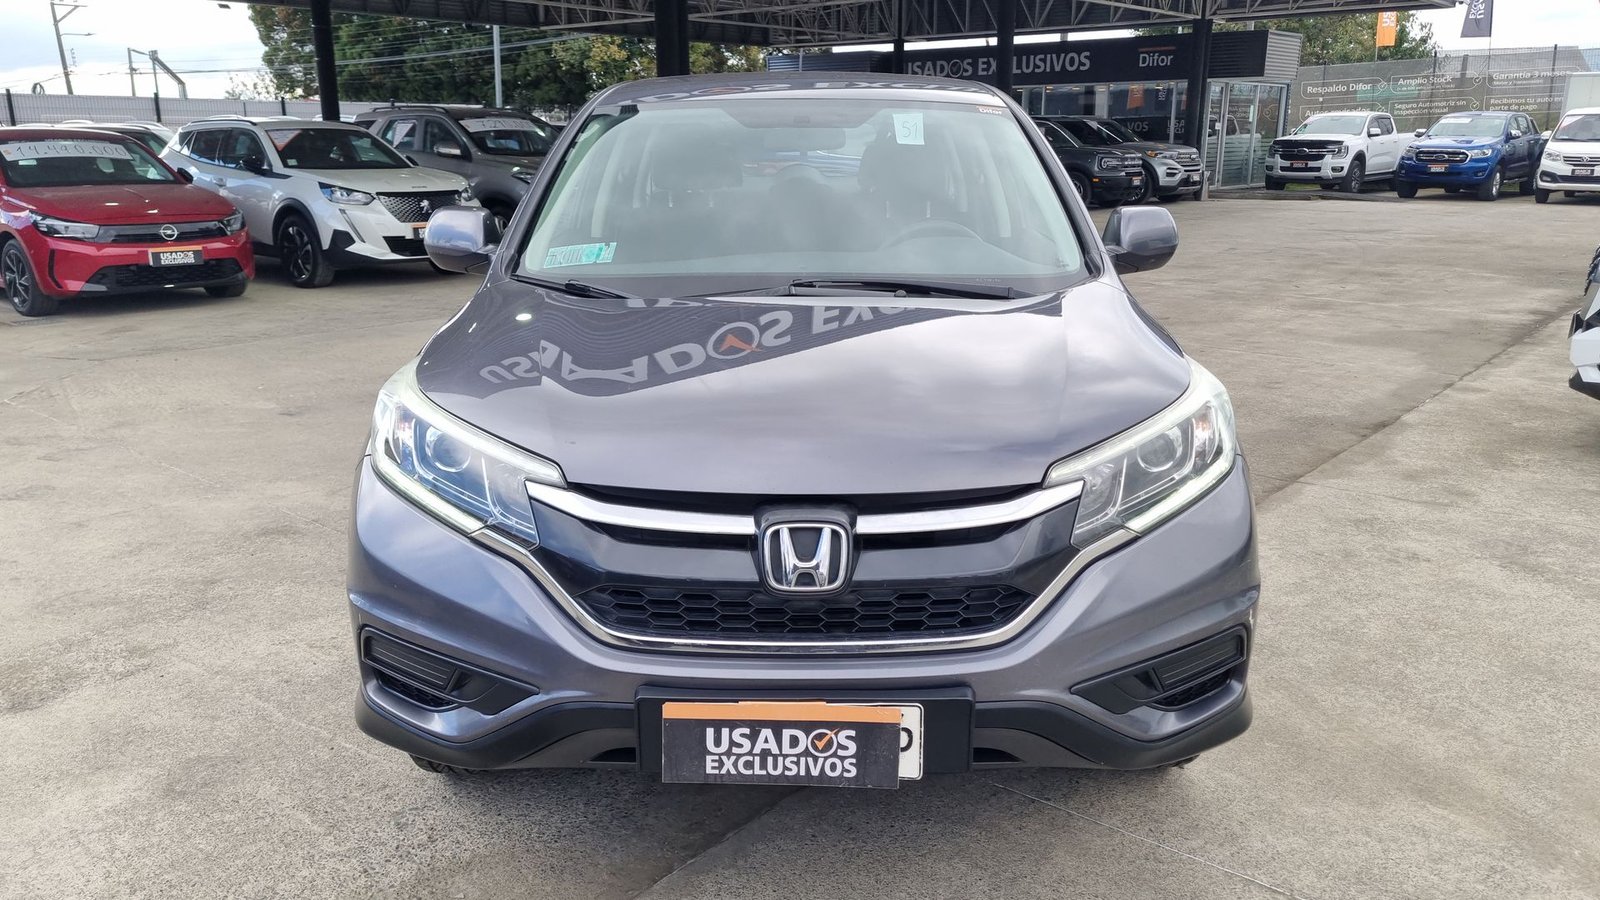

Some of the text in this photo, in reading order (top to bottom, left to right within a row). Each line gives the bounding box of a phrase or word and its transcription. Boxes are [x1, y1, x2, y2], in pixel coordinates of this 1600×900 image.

[1139, 53, 1174, 67] Difor
[1398, 75, 1453, 86] Amplio Stock
[1532, 70, 1539, 79] 3
[1307, 82, 1373, 95] Respaldo Difor
[1394, 101, 1418, 110] Seguro
[1520, 104, 1538, 112] pago
[902, 120, 919, 138] 51
[160, 251, 195, 260] USADOS
[705, 727, 858, 758] USADOS
[705, 755, 858, 778] EXCLUSIVOS
